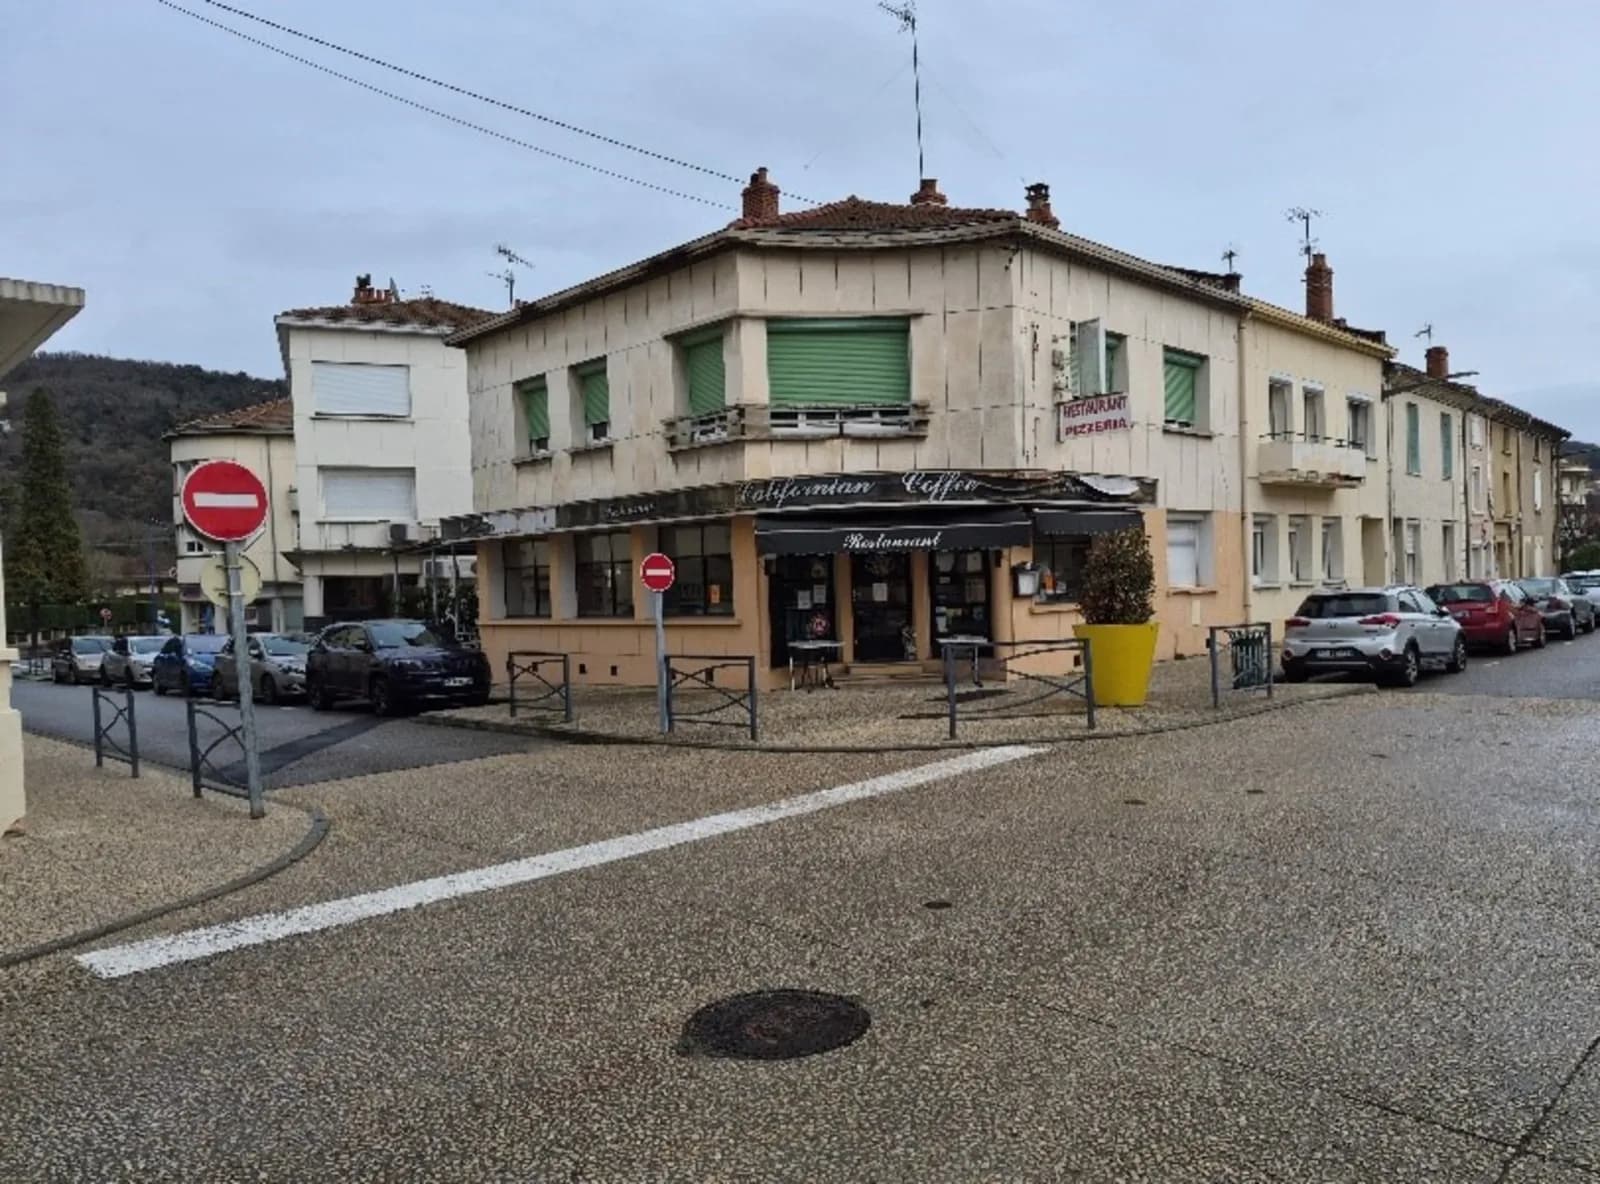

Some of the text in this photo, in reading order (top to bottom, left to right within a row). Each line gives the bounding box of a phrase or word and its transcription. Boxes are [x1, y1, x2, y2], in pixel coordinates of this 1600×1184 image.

[1063, 396, 1128, 418] RESTAURANT
[1065, 418, 1127, 436] PIZZERIA
[843, 531, 942, 549] Restaurant
